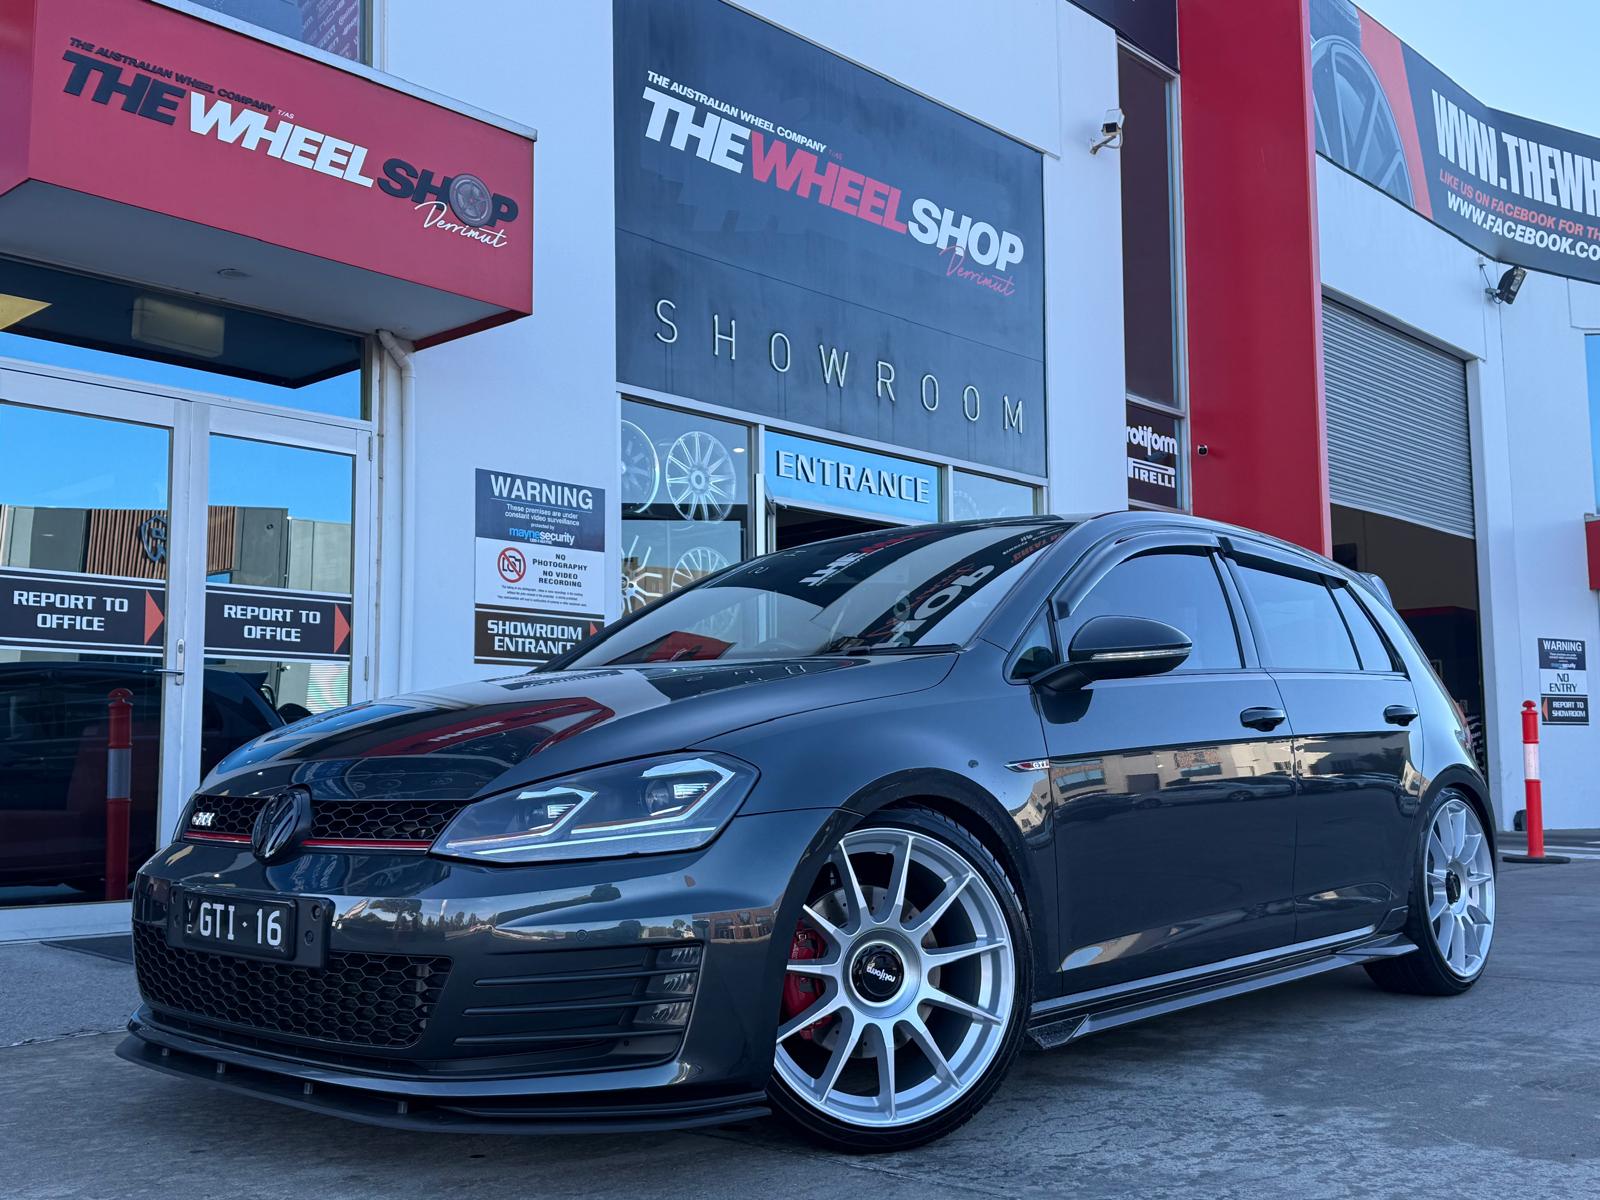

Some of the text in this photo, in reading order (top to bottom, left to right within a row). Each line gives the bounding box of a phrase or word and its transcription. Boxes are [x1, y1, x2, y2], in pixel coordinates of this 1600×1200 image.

[70, 37, 95, 52] THE
[96, 47, 173, 78] AUSTRALIAN
[175, 72, 215, 94] WHEEL
[217, 88, 276, 112] COMPANY
[62, 50, 187, 126] THE
[190, 91, 374, 188] WHEEL
[647, 70, 670, 88] THE
[670, 82, 739, 117] AUSTRALIAN
[740, 110, 775, 133] WHEEL
[777, 126, 827, 153] COMPANY
[642, 86, 1024, 271] THE WHEEL SHOP
[1439, 168, 1459, 191] LIKE
[1460, 181, 1474, 199] US
[1474, 190, 1490, 208] ON
[1490, 197, 1556, 230] FACEBOOK
[1558, 219, 1584, 236] FOR
[414, 201, 507, 247] Derrimut
[939, 245, 1015, 296] Derrimut
[655, 299, 1024, 434] SHOWROOM
[1127, 425, 1178, 456] rotiform
[776, 449, 930, 504] ENTRANCE
[1128, 456, 1176, 489] PIRELLI
[490, 474, 593, 510] WARNING
[505, 511, 580, 526] constant video surveillance
[507, 504, 524, 512] These
[526, 507, 551, 516] premises
[532, 558, 588, 571] PHOTOGRAPHY
[555, 553, 566, 561] NO
[539, 577, 582, 588] RECORDING
[556, 572, 578, 580] VIDEO
[13, 590, 129, 613] REPORT TO
[36, 613, 105, 632] OFFICE
[223, 604, 321, 625] REPORT TO
[243, 625, 301, 643] OFFICE
[487, 619, 582, 641] SHOWROOM
[1543, 640, 1582, 652] WARNING
[1549, 683, 1577, 693] ENTRY
[1557, 672, 1570, 682] NO
[1552, 710, 1586, 718] SHOWROOM
[1576, 701, 1584, 709] TO
[200, 902, 282, 946] GTI 16
